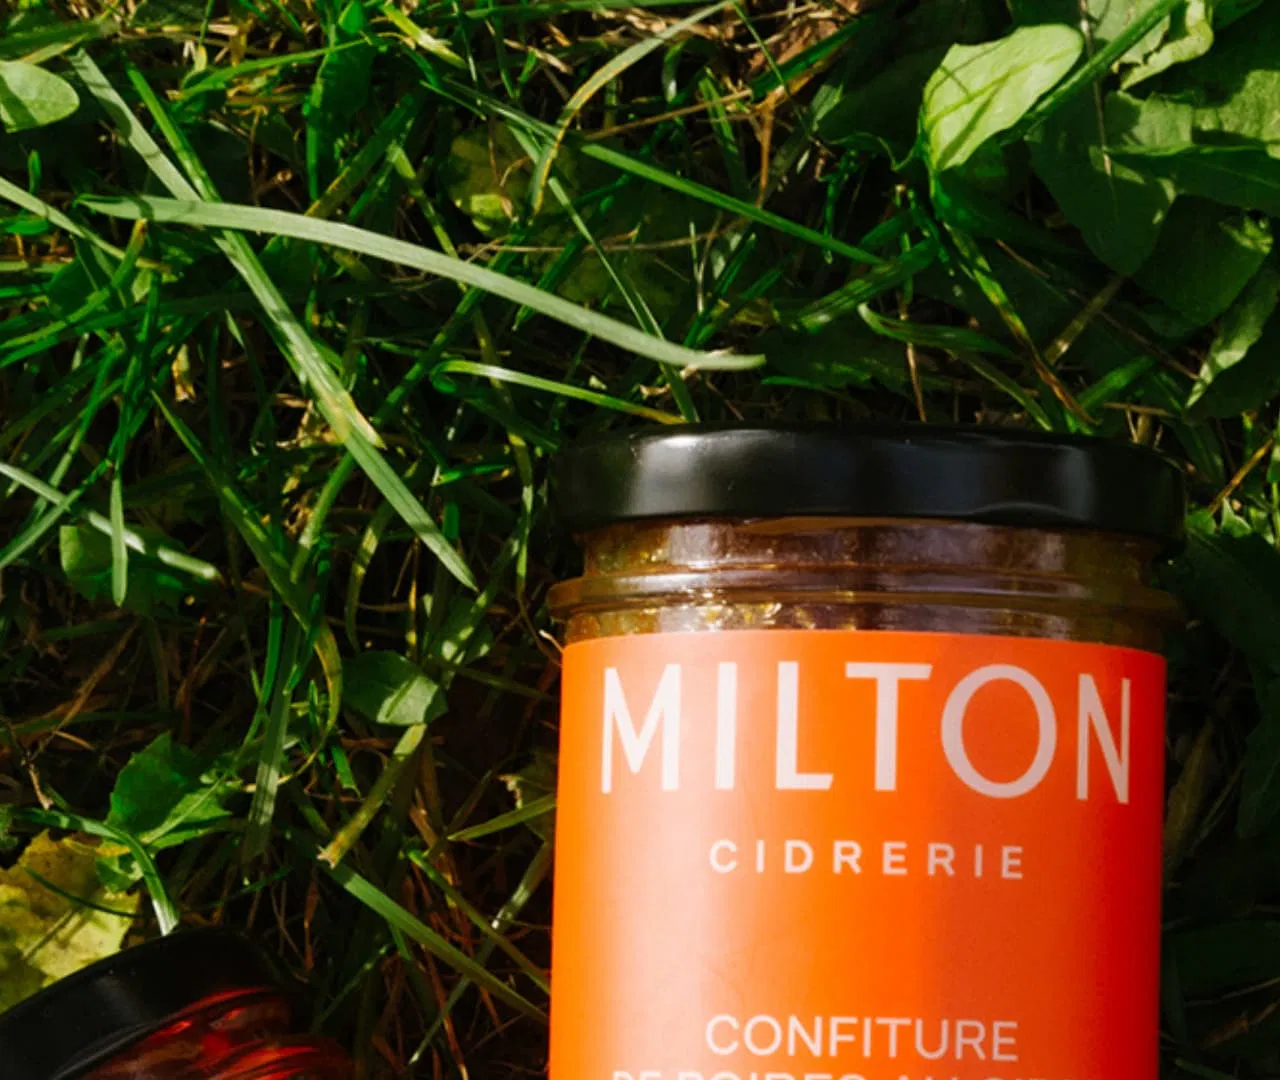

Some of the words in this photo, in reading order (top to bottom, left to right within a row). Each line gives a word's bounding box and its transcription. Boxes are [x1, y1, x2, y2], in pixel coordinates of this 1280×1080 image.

[600, 660, 1132, 804] MILTON
[709, 839, 1024, 880] CIDRERIE
[705, 1013, 1019, 1062] CONFITURE
